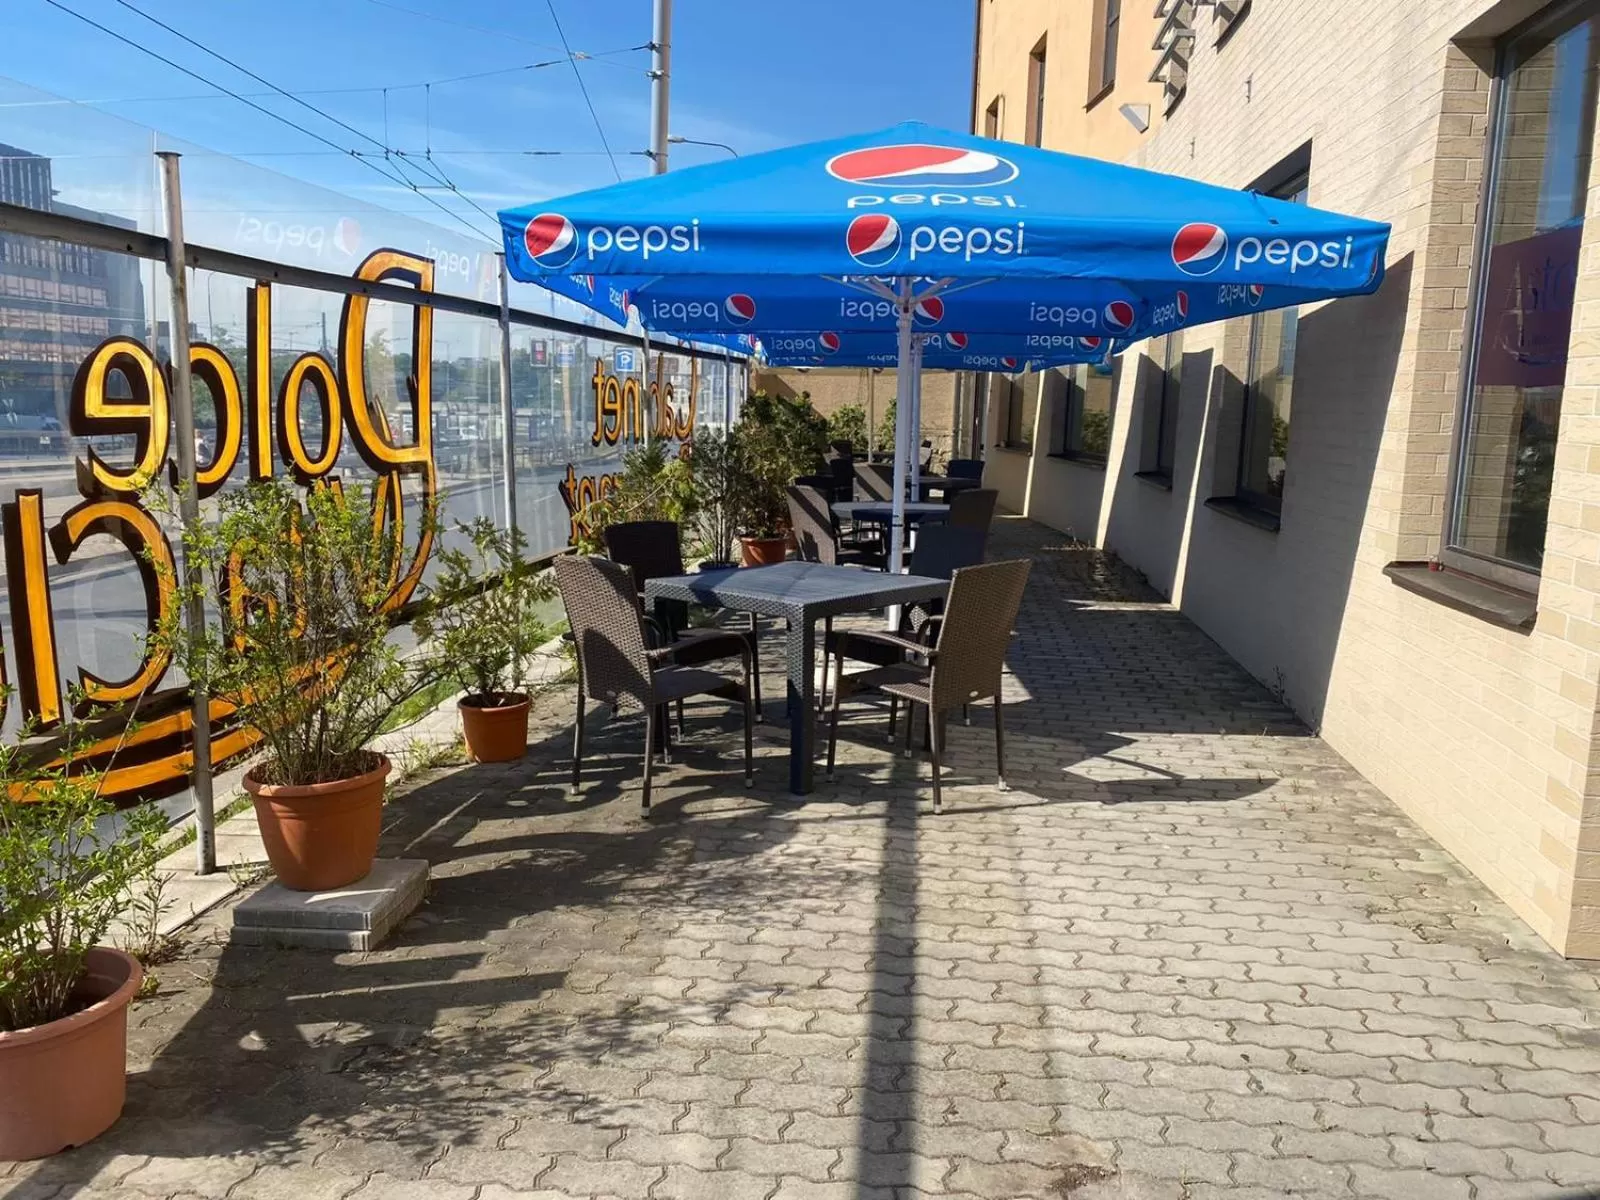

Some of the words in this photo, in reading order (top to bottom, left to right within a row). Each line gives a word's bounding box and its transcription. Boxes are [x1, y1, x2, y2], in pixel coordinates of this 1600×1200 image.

[847, 193, 1017, 208] pepsi
[587, 218, 700, 260] pepsi
[910, 222, 1025, 261] pepsi
[1234, 236, 1354, 273] pepsi
